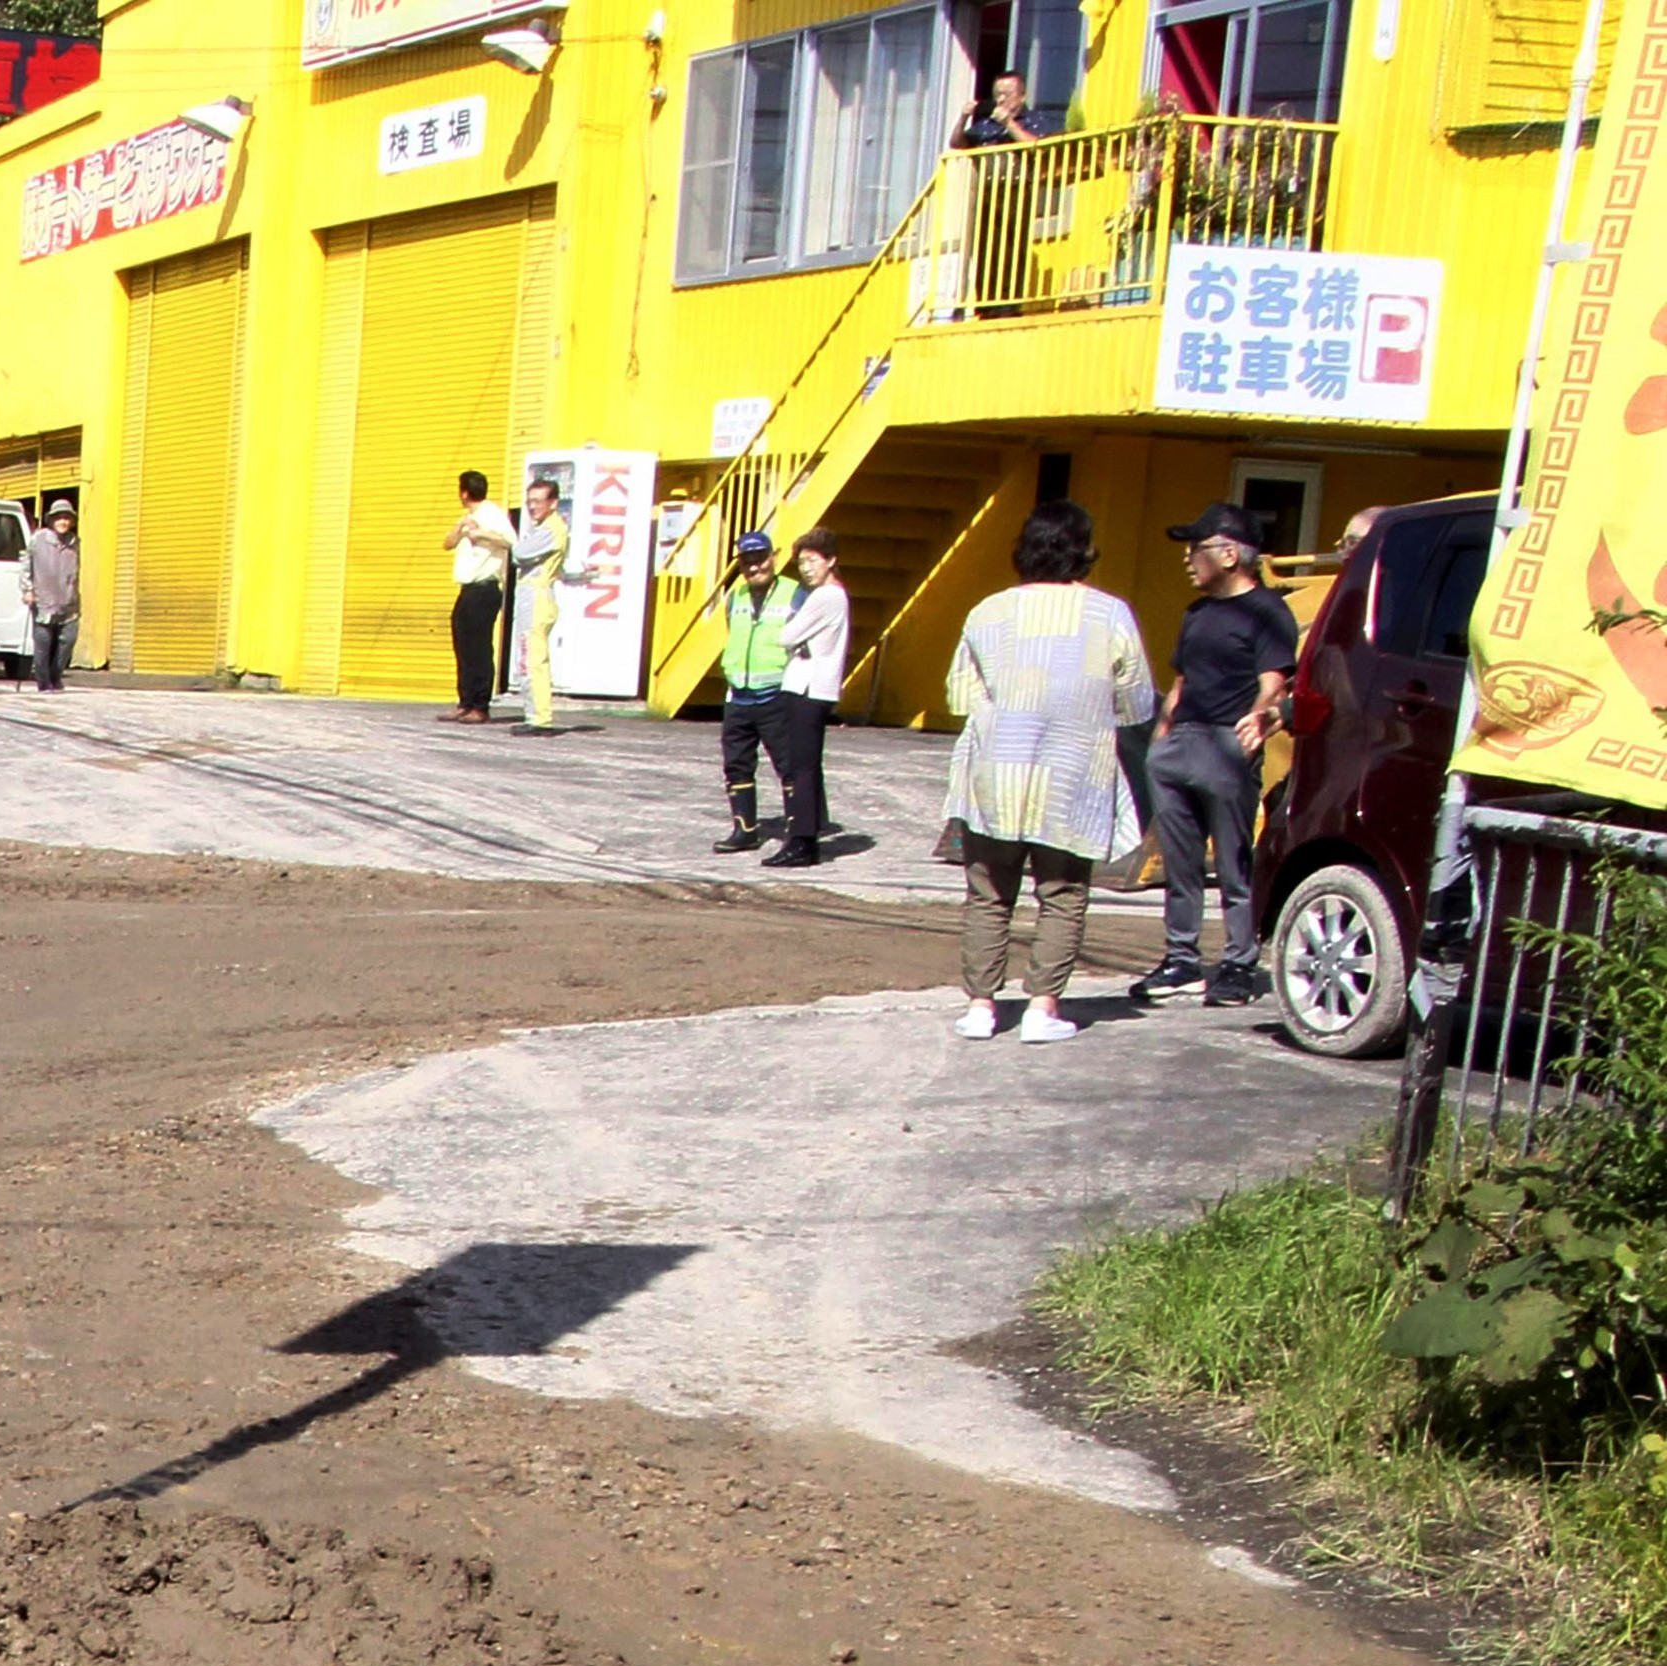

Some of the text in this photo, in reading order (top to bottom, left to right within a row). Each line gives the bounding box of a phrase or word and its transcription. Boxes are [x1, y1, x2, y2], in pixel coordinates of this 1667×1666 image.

[387, 108, 471, 164] 検査場
[1184, 260, 1360, 332] お客様
[1174, 331, 1351, 401] 駐車場
[1359, 294, 1428, 384] P
[583, 462, 631, 620] KIRIN
